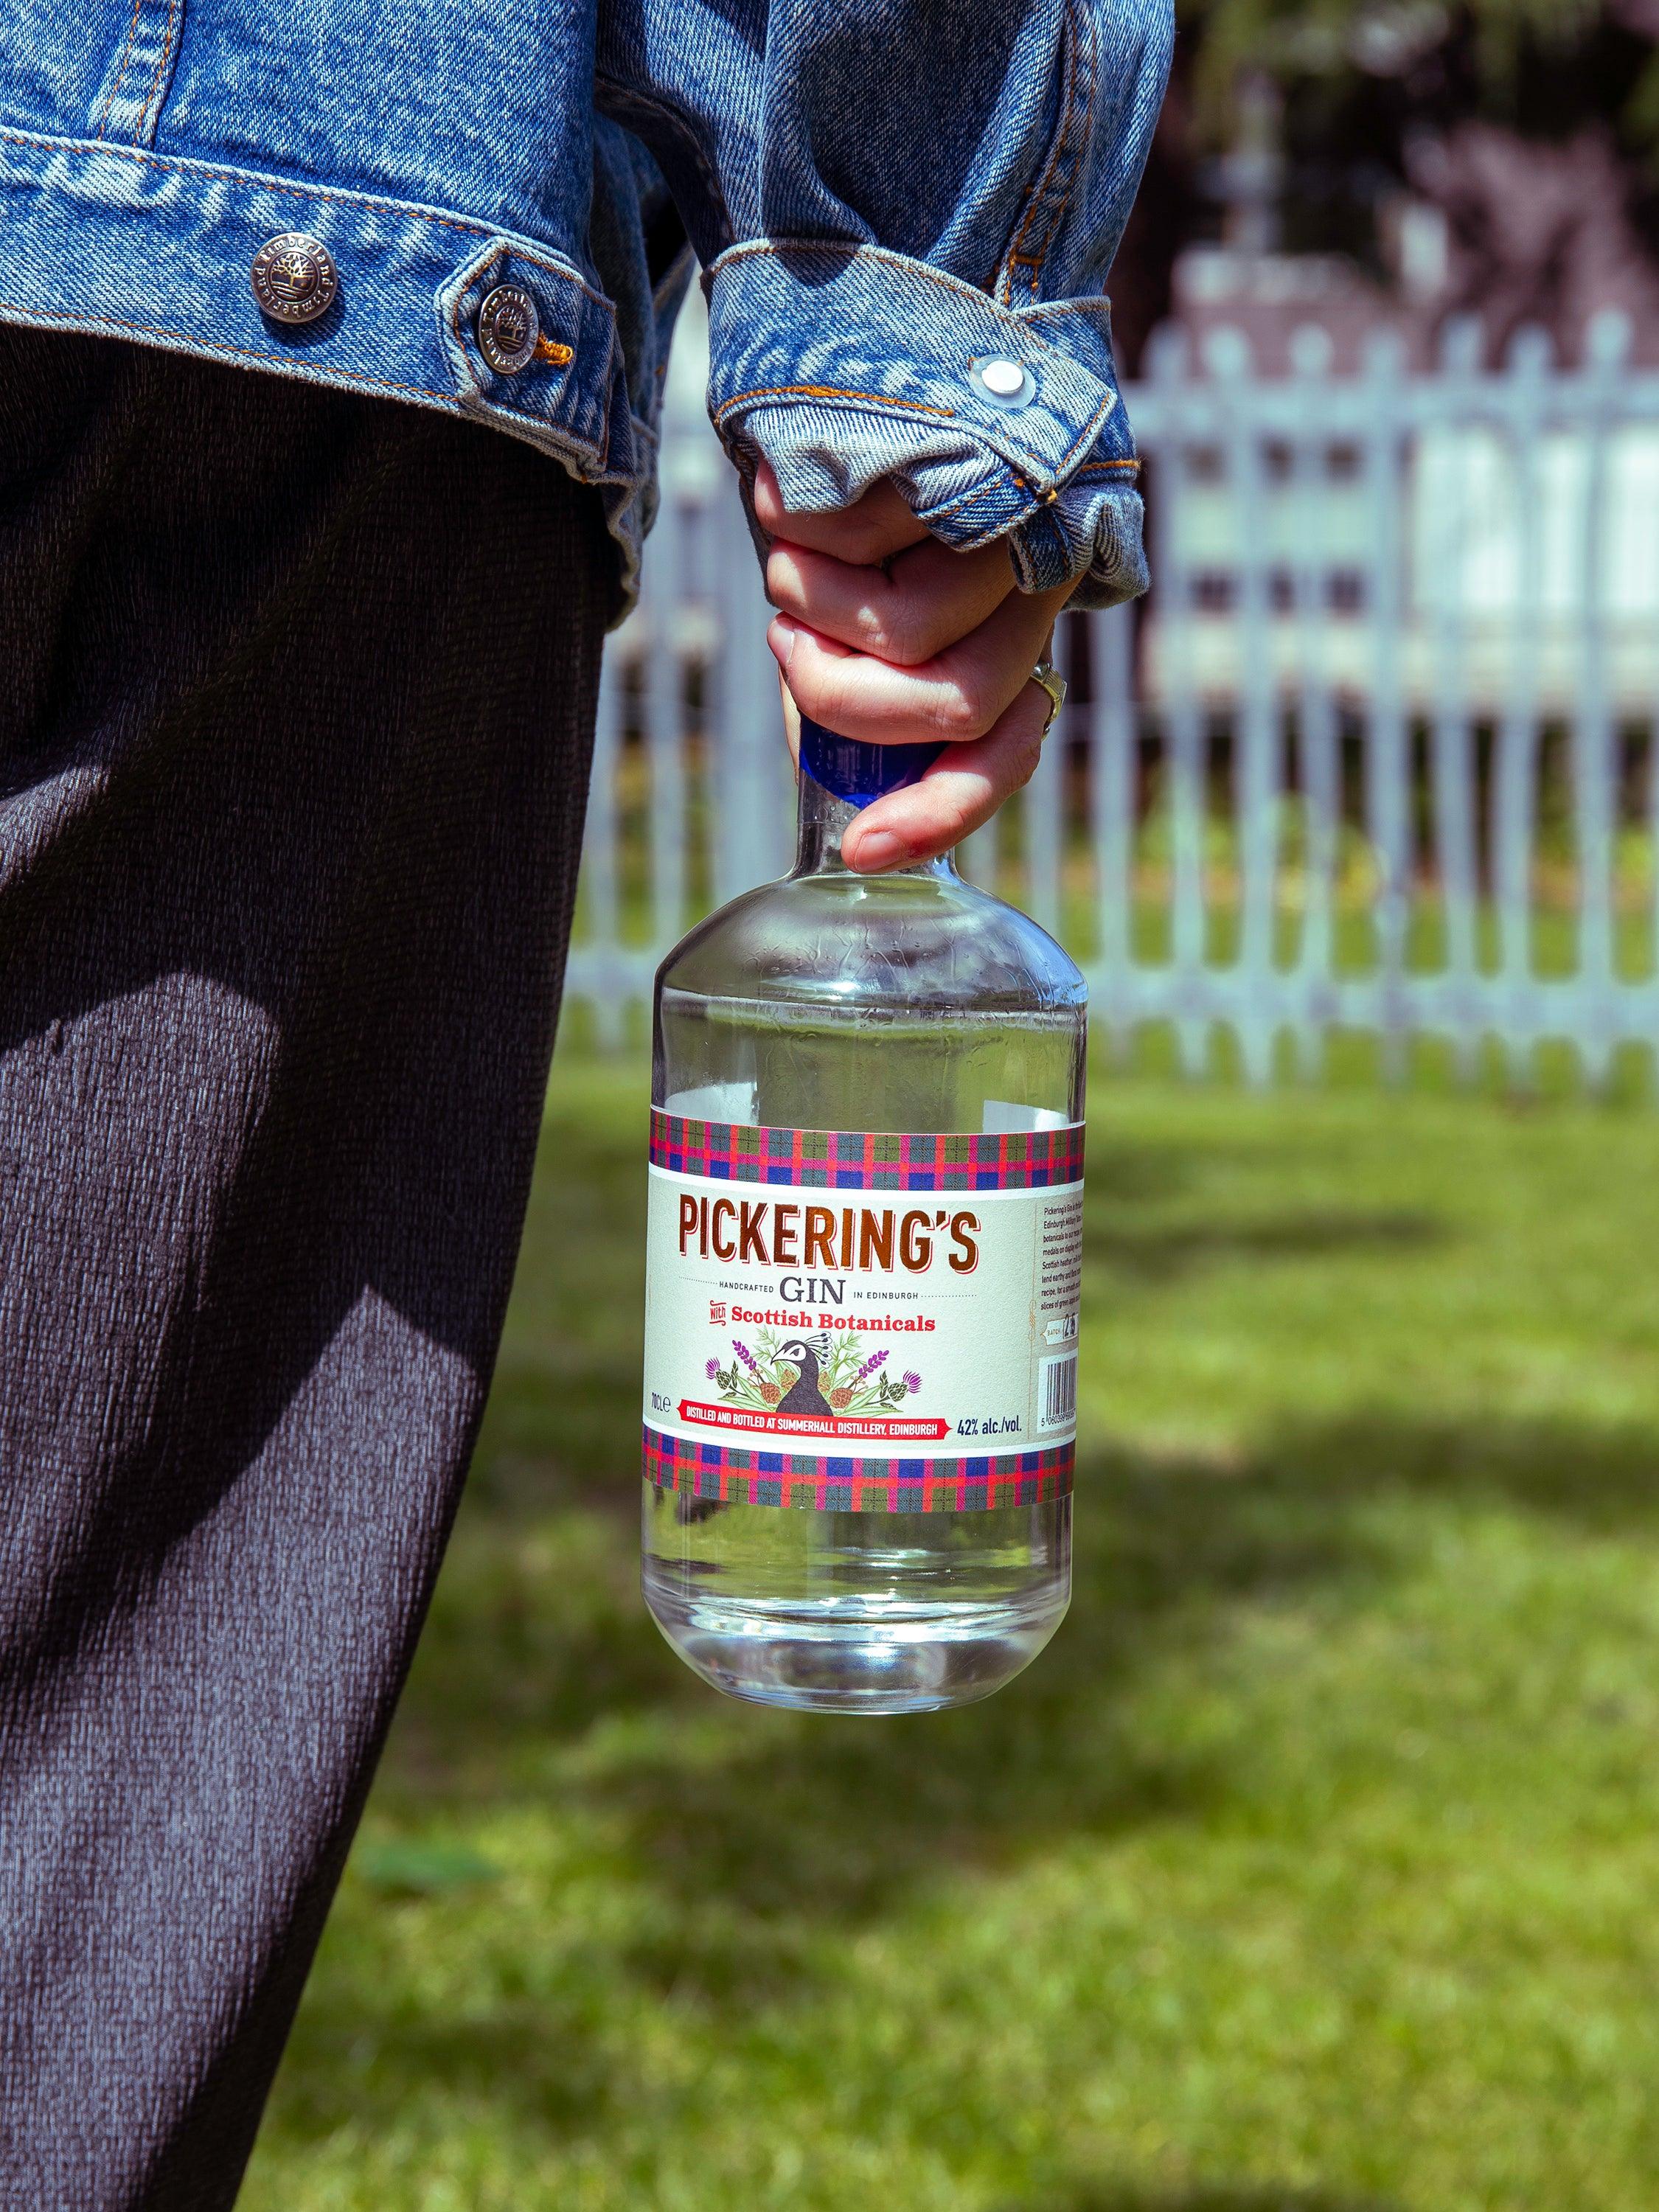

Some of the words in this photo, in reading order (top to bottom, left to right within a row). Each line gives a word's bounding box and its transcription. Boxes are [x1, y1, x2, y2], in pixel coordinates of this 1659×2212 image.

[256, 235, 334, 287] Timberland
[679, 1193, 981, 1275] PICKERING'S
[719, 1280, 773, 1293] HANDCRAFTED
[779, 1276, 846, 1304] GIN
[866, 1292, 919, 1300] EDINBURGH
[731, 1306, 813, 1328] Scottish
[818, 1313, 936, 1332] Botanicals
[686, 1405, 716, 1422] DISTILLED
[717, 1413, 731, 1424] AND
[733, 1413, 765, 1428] BOTTLED
[766, 1417, 776, 1429] AT
[777, 1418, 835, 1433] SUMMERHALL
[889, 1423, 938, 1436] EDINBURGH
[957, 1418, 978, 1436] 42%
[982, 1415, 1022, 1434] alc./vol.
[1040, 1417, 1046, 1427] 5
